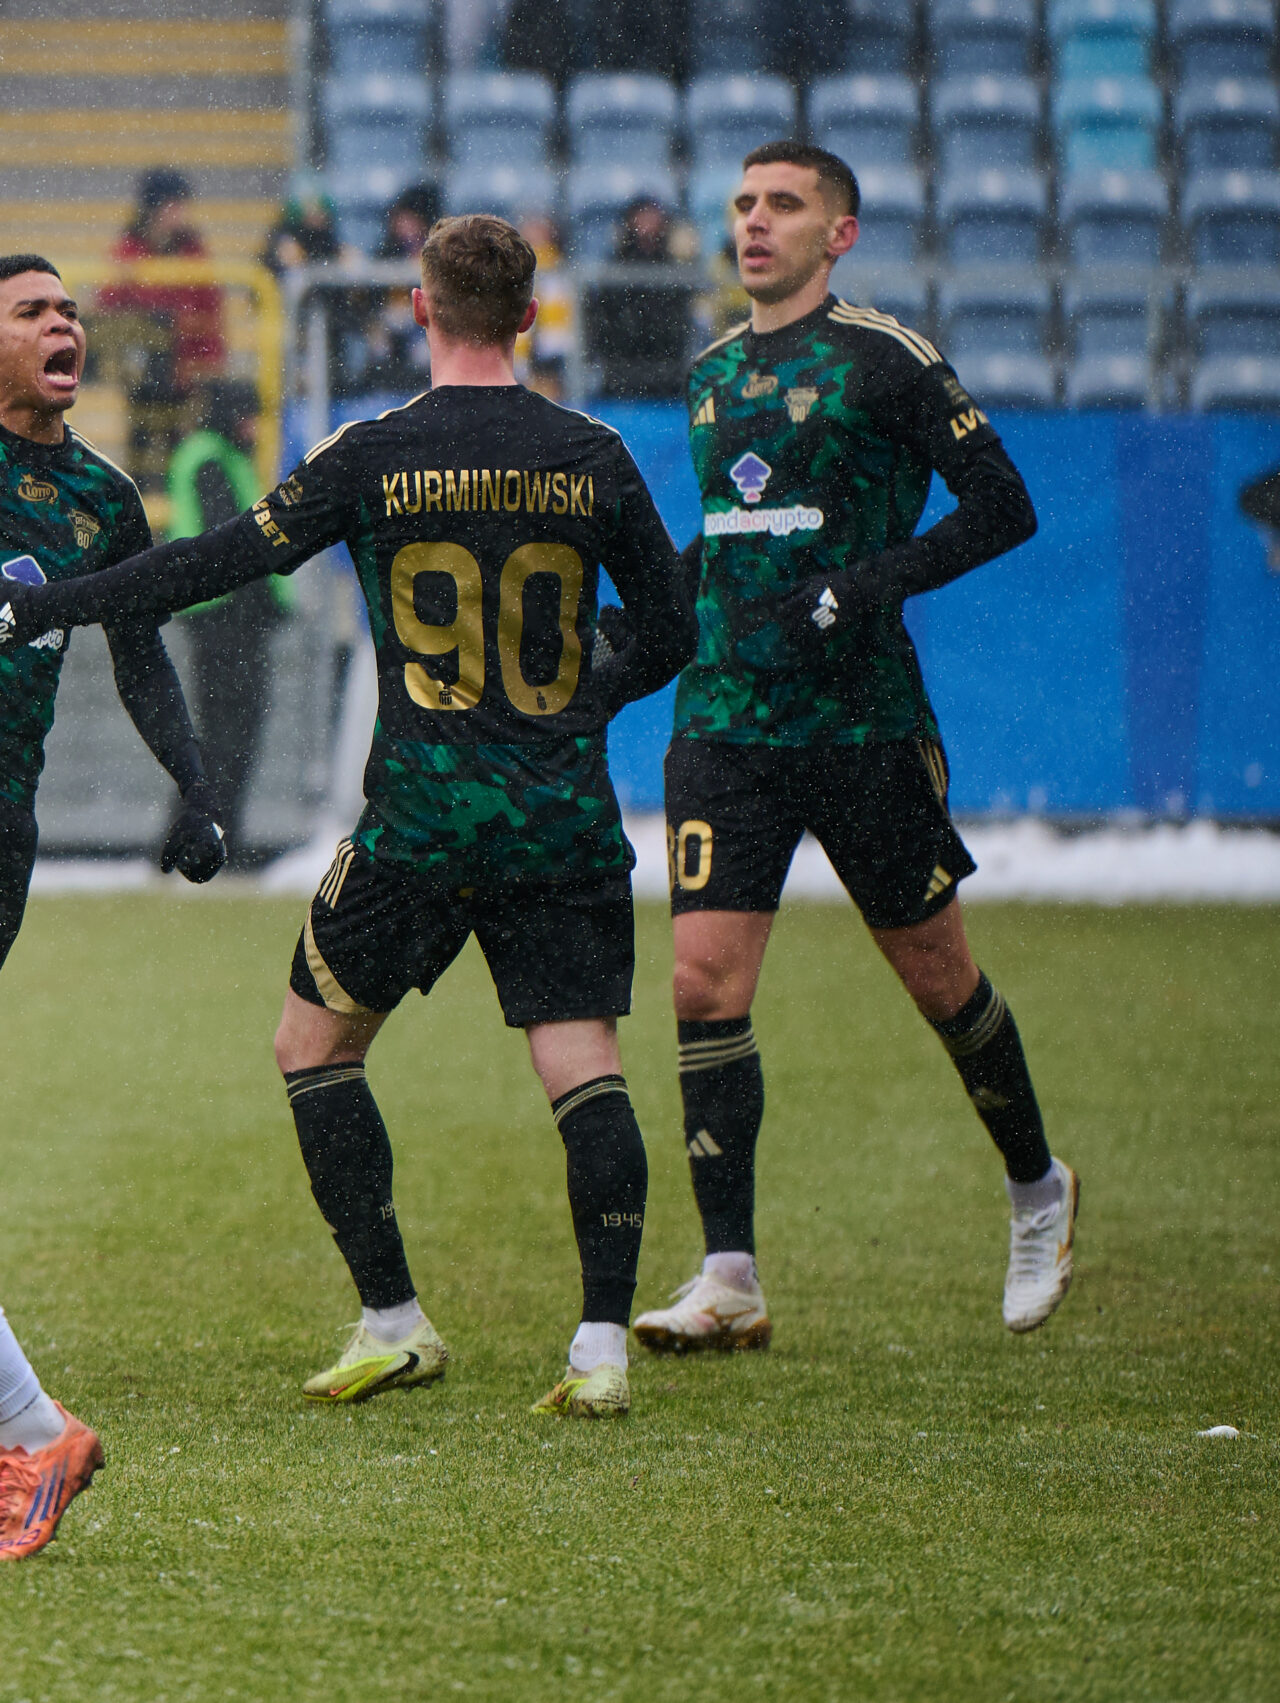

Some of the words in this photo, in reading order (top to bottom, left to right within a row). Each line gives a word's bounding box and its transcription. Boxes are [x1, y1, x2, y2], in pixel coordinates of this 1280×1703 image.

[25, 485, 51, 498] LOTTO
[382, 468, 595, 517] KURMINOWSKI
[77, 530, 90, 549] 80
[391, 541, 583, 716] 90
[600, 1212, 643, 1228] 1945
